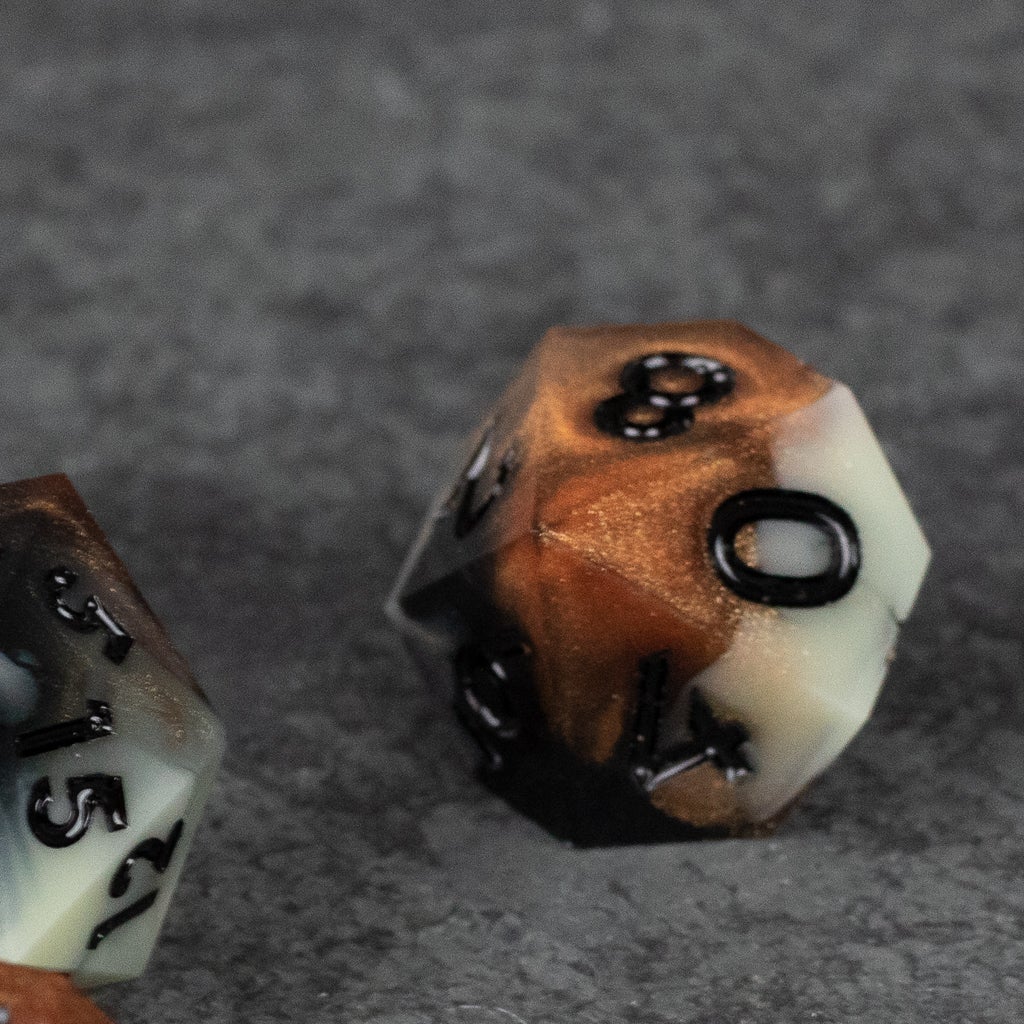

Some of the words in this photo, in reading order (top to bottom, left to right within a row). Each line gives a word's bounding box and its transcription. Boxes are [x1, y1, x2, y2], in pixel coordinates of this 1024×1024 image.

[594, 350, 735, 443] 8
[708, 487, 861, 609] 0
[628, 650, 756, 796] 4
